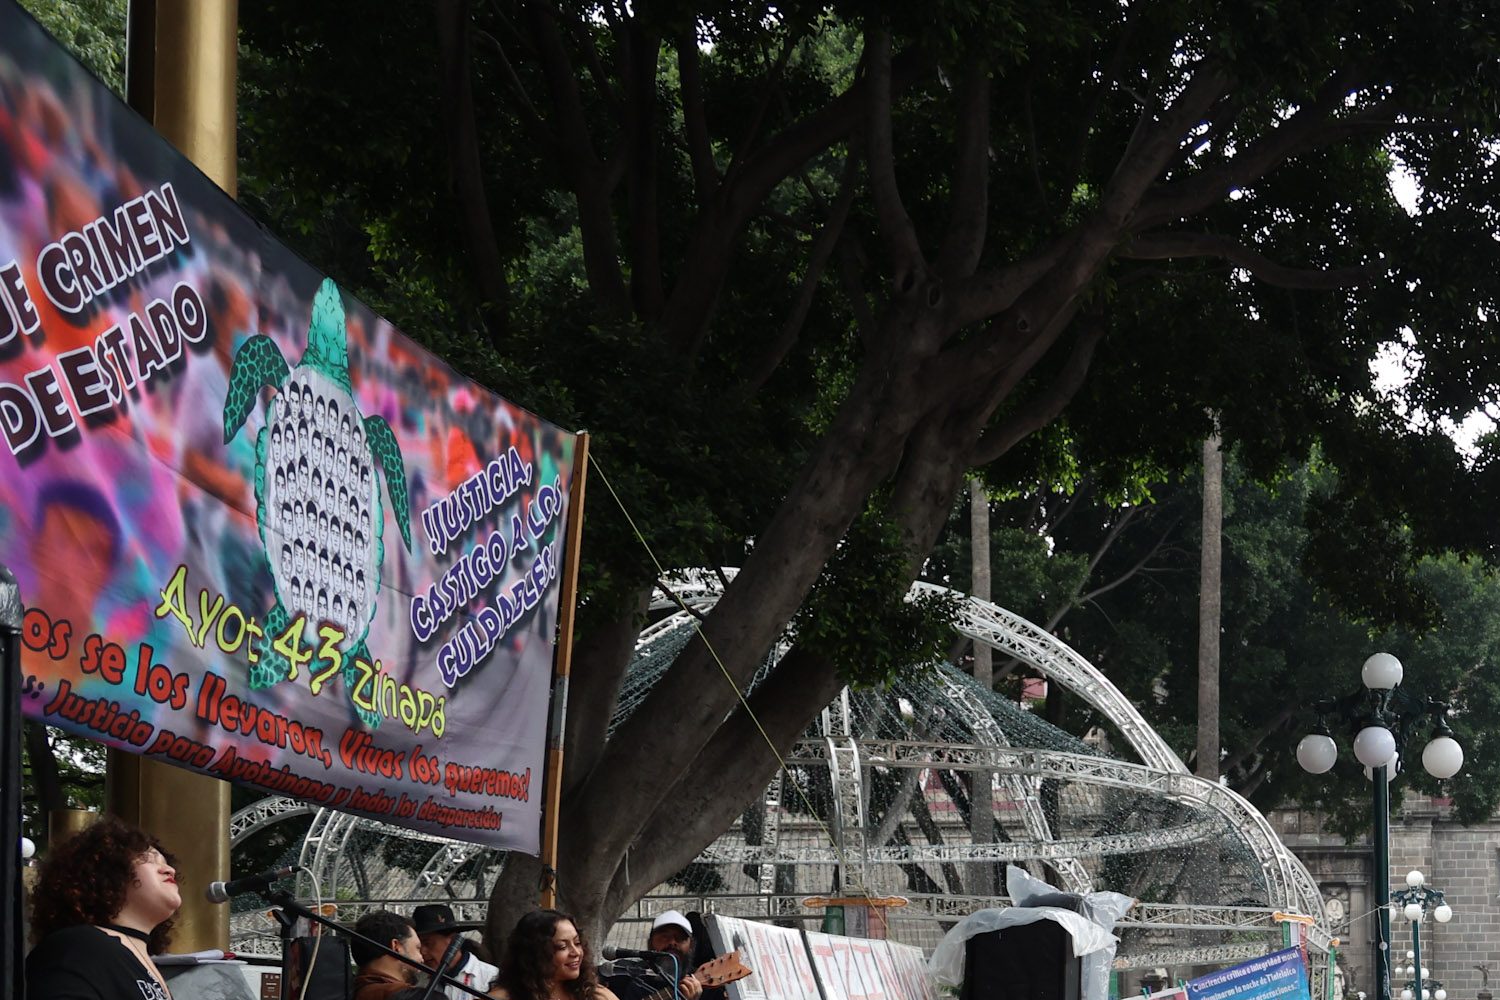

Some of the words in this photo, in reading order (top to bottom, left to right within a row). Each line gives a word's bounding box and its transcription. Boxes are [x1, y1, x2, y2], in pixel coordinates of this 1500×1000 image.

[37, 183, 189, 313] CRIMEN
[0, 364, 76, 455] DE
[56, 282, 207, 416] ESTADO
[410, 531, 506, 643] CASTIGO
[510, 514, 528, 560] A
[526, 474, 563, 540] LOS
[436, 541, 556, 689] CULPABLES!
[80, 634, 126, 685] se
[134, 643, 190, 710] los
[196, 671, 332, 769] llevaron,
[409, 744, 440, 785] los
[445, 761, 531, 802] queremos!
[273, 614, 346, 697] 43
[351, 658, 446, 740] zinapa
[44, 679, 154, 747] Justicia
[146, 729, 216, 768] para
[208, 747, 335, 804] Ayotzinapa
[331, 783, 352, 806] y
[350, 785, 395, 816] todos
[396, 793, 419, 819] los
[417, 796, 503, 831] desaparecidos
[1235, 984, 1242, 993] la
[1242, 979, 1260, 992] noche
[1260, 976, 1268, 985] de
[1266, 968, 1297, 983] Tlatelolco
